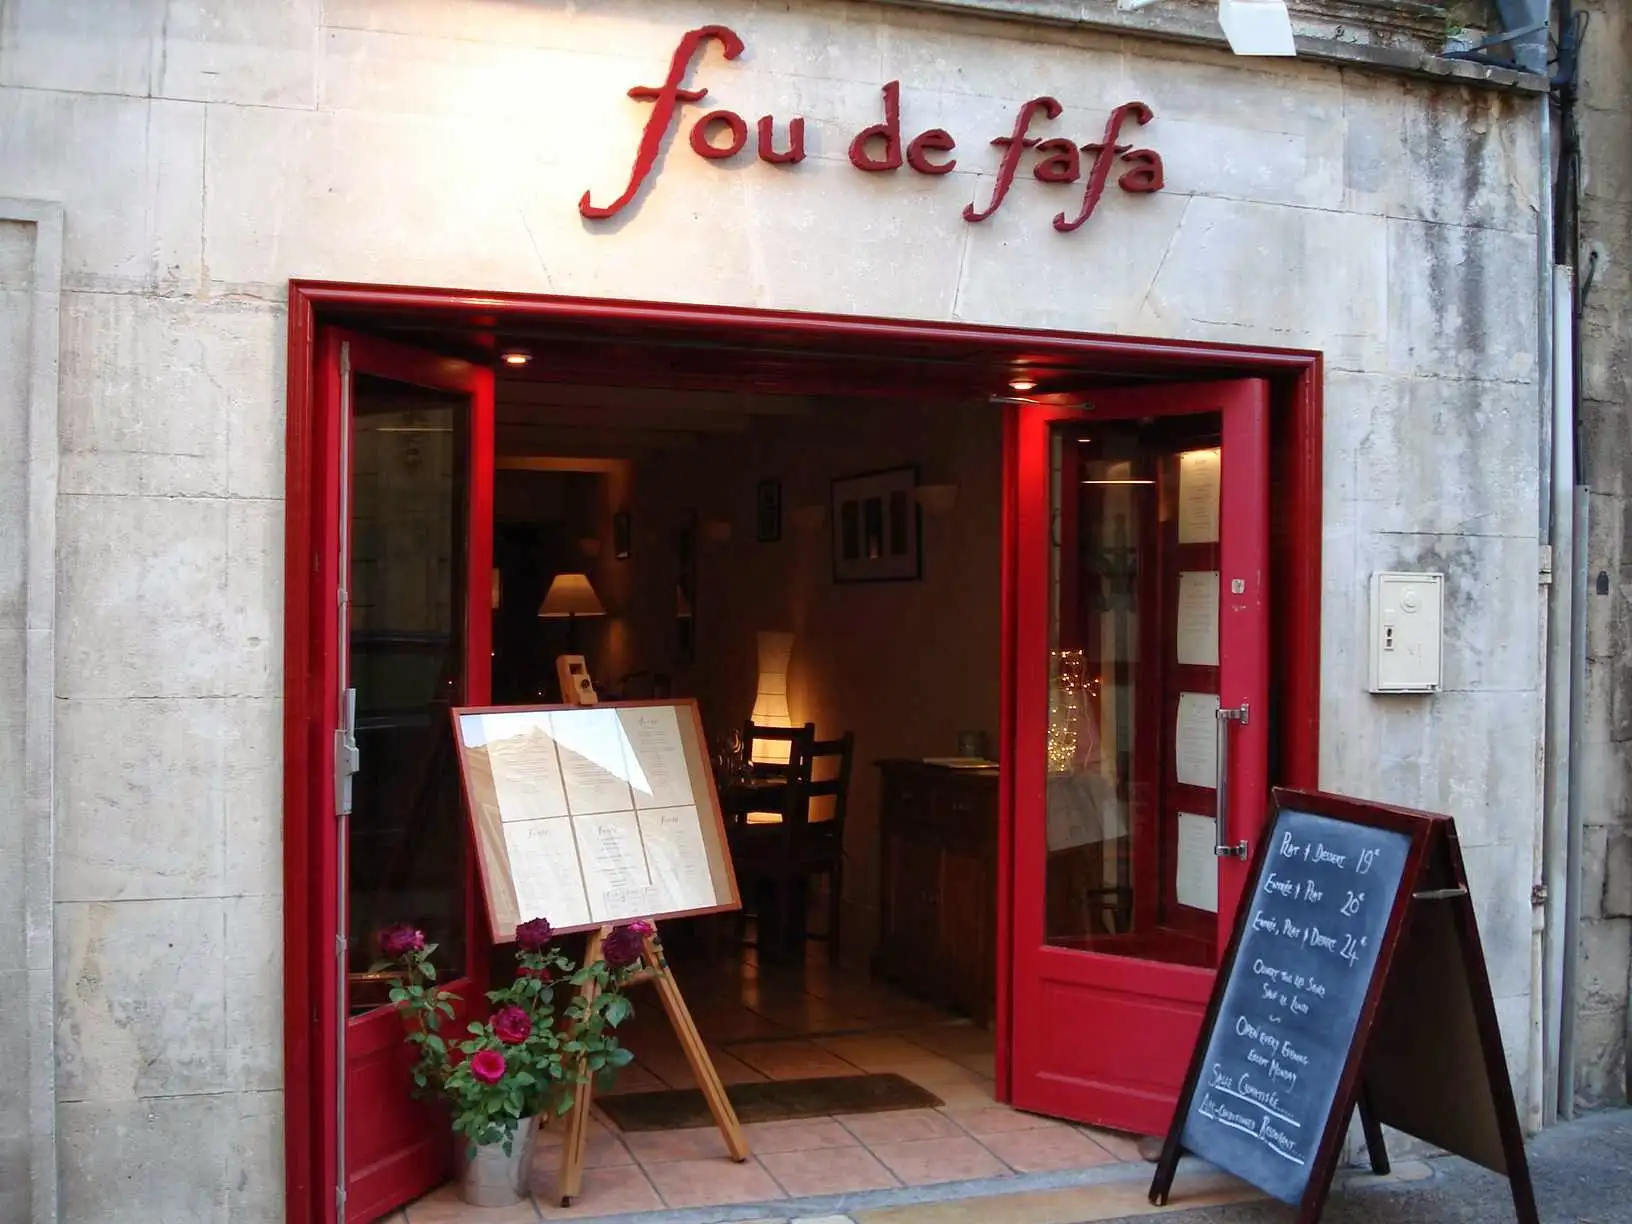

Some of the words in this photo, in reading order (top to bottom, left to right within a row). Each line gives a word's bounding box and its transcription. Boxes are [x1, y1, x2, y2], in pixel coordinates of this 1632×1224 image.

[579, 25, 806, 220] fou
[848, 80, 957, 174] de
[963, 97, 1166, 232] fafa
